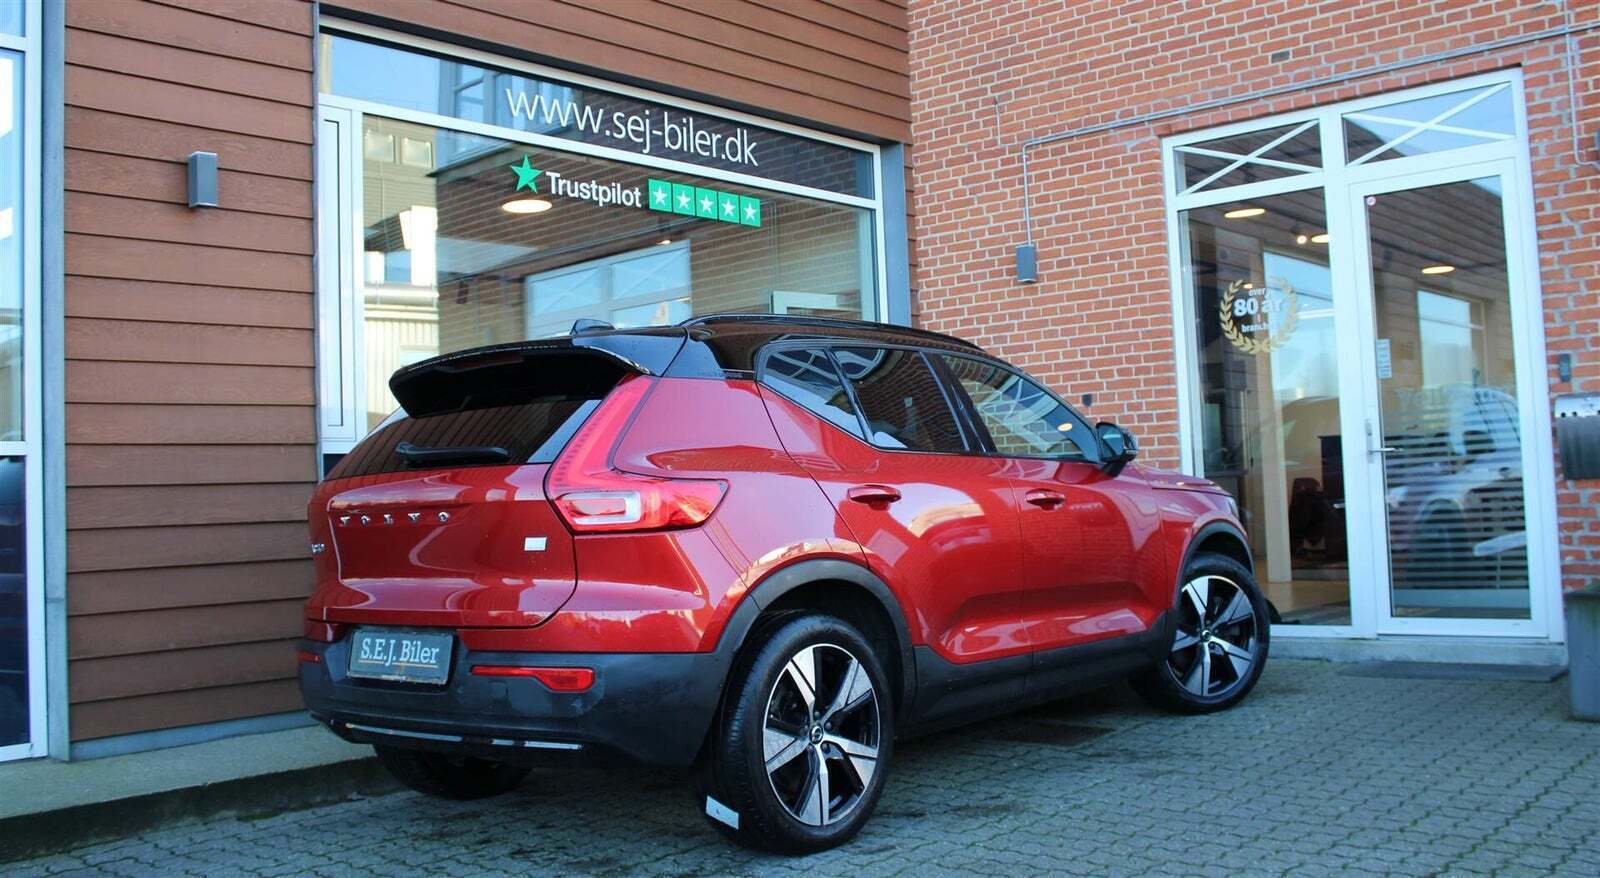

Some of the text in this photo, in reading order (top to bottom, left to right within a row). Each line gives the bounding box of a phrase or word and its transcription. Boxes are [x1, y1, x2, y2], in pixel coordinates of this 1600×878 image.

[505, 88, 759, 167] www.sej-biler.dk
[546, 171, 642, 208] Trustpilot
[1233, 297, 1259, 317] 80
[360, 637, 440, 667] S.E.J. Biler
